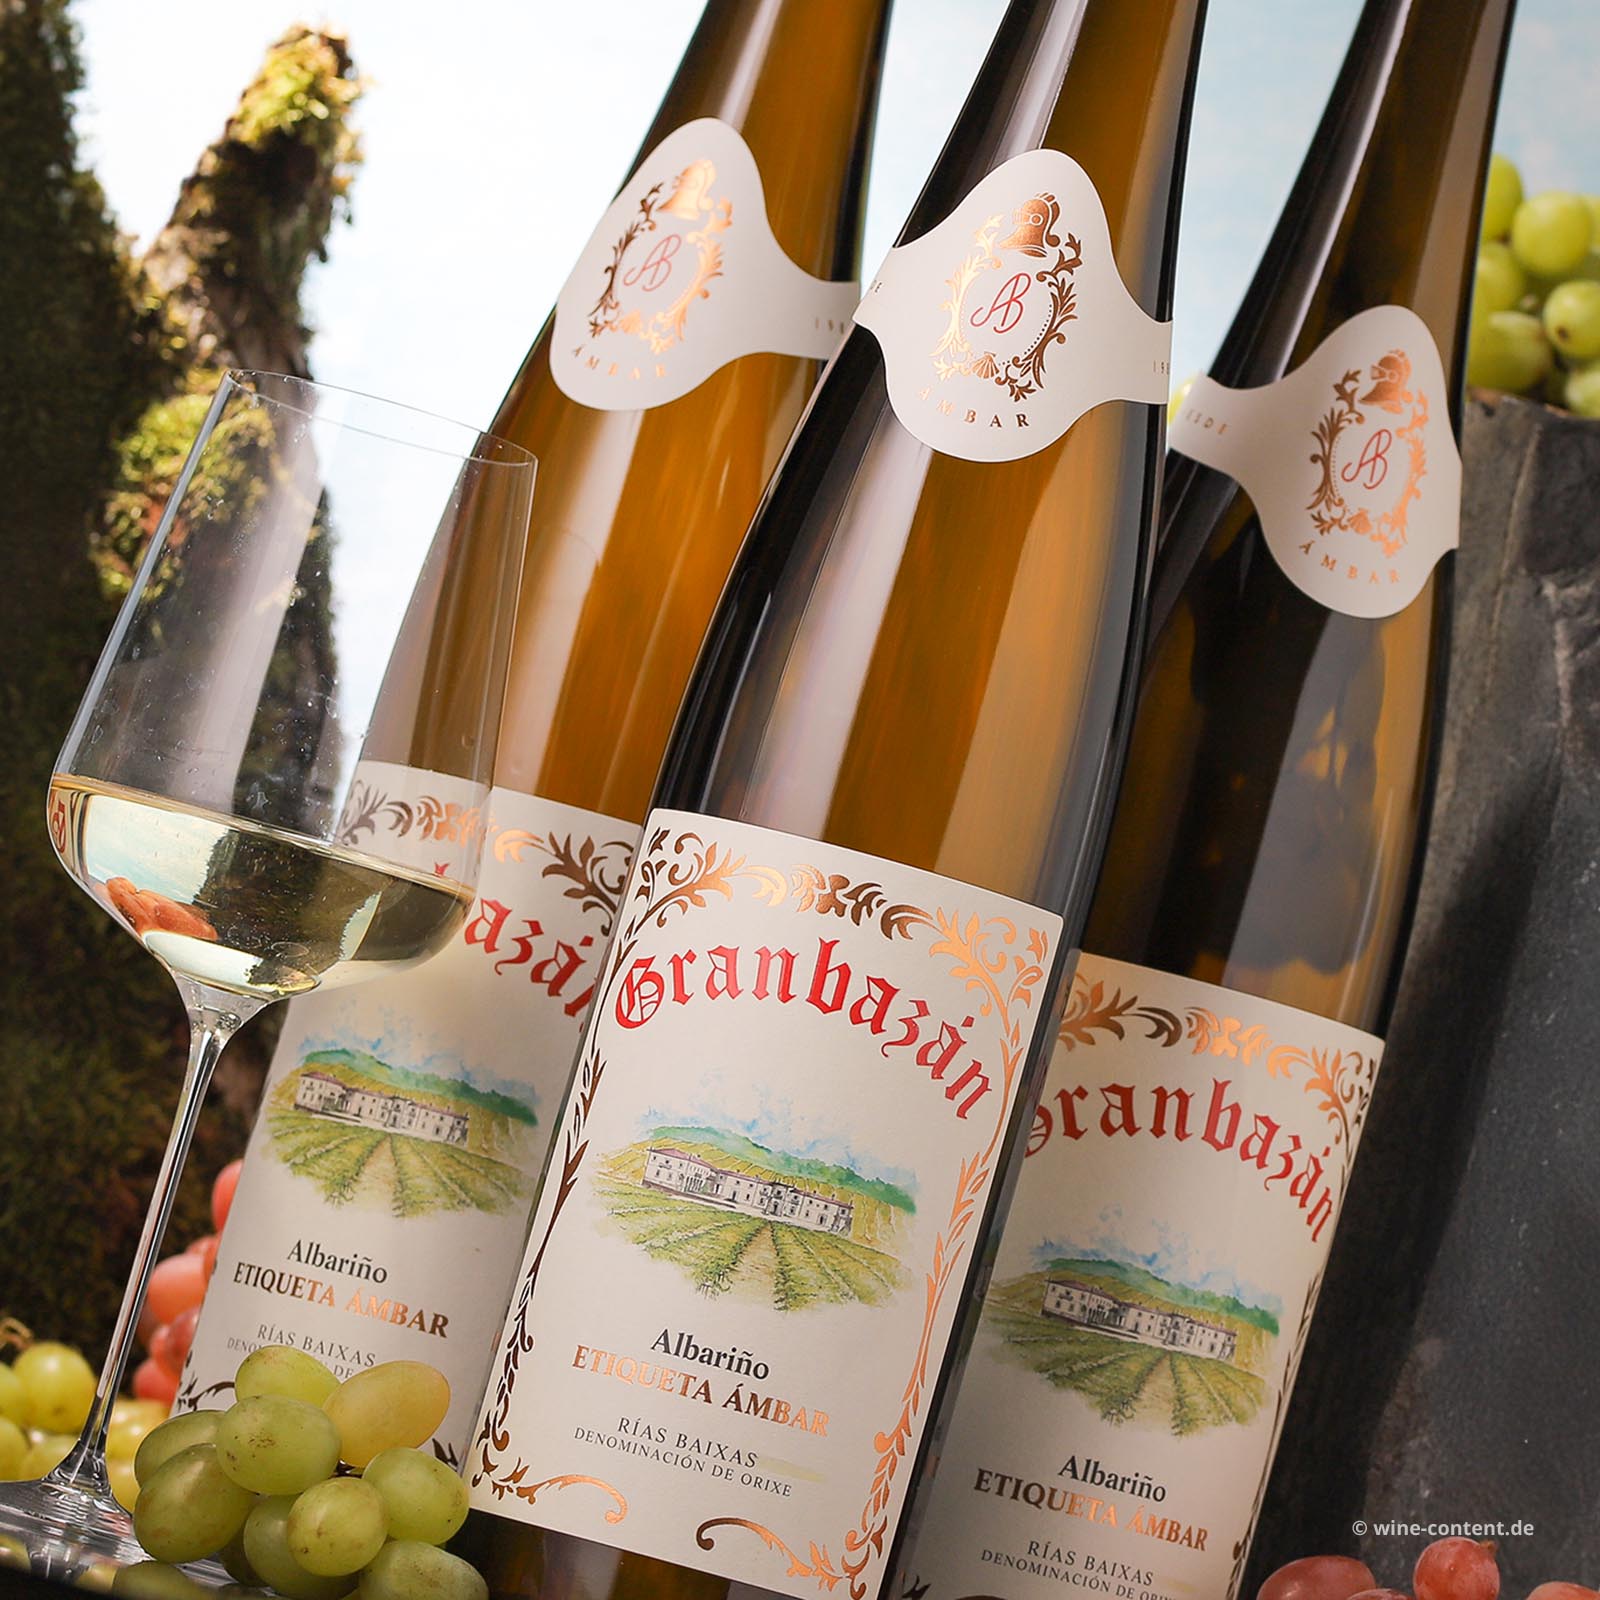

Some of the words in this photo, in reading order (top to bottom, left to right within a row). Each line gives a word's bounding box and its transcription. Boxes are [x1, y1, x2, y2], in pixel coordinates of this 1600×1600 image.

[615, 936, 993, 1120] Granbazán
[287, 1239, 389, 1284] Albariño
[232, 1261, 336, 1308] ETIQUETA
[344, 1285, 450, 1339] ÁMBAR
[257, 1323, 297, 1347] RÍAS
[302, 1335, 377, 1368] BAIXAS
[650, 1328, 770, 1381] Albariño
[572, 1344, 713, 1405] ETIQUETA
[721, 1383, 831, 1438] ÁMBAR
[574, 1426, 706, 1473] DENOMINACIÓN
[711, 1464, 735, 1481] DE
[740, 1472, 793, 1498] ORIXE
[617, 1416, 668, 1444] RÍAS
[675, 1433, 759, 1468] BAIXAS
[1057, 1455, 1167, 1503] Albariño
[973, 1467, 1118, 1528] ETIQUETA
[1125, 1504, 1209, 1551] ÁMBAR
[981, 1549, 1111, 1593] DENOMINACIÓN
[1115, 1584, 1135, 1600] DE
[1027, 1540, 1076, 1567] RÍAS
[1083, 1555, 1154, 1586] BAIXAS
